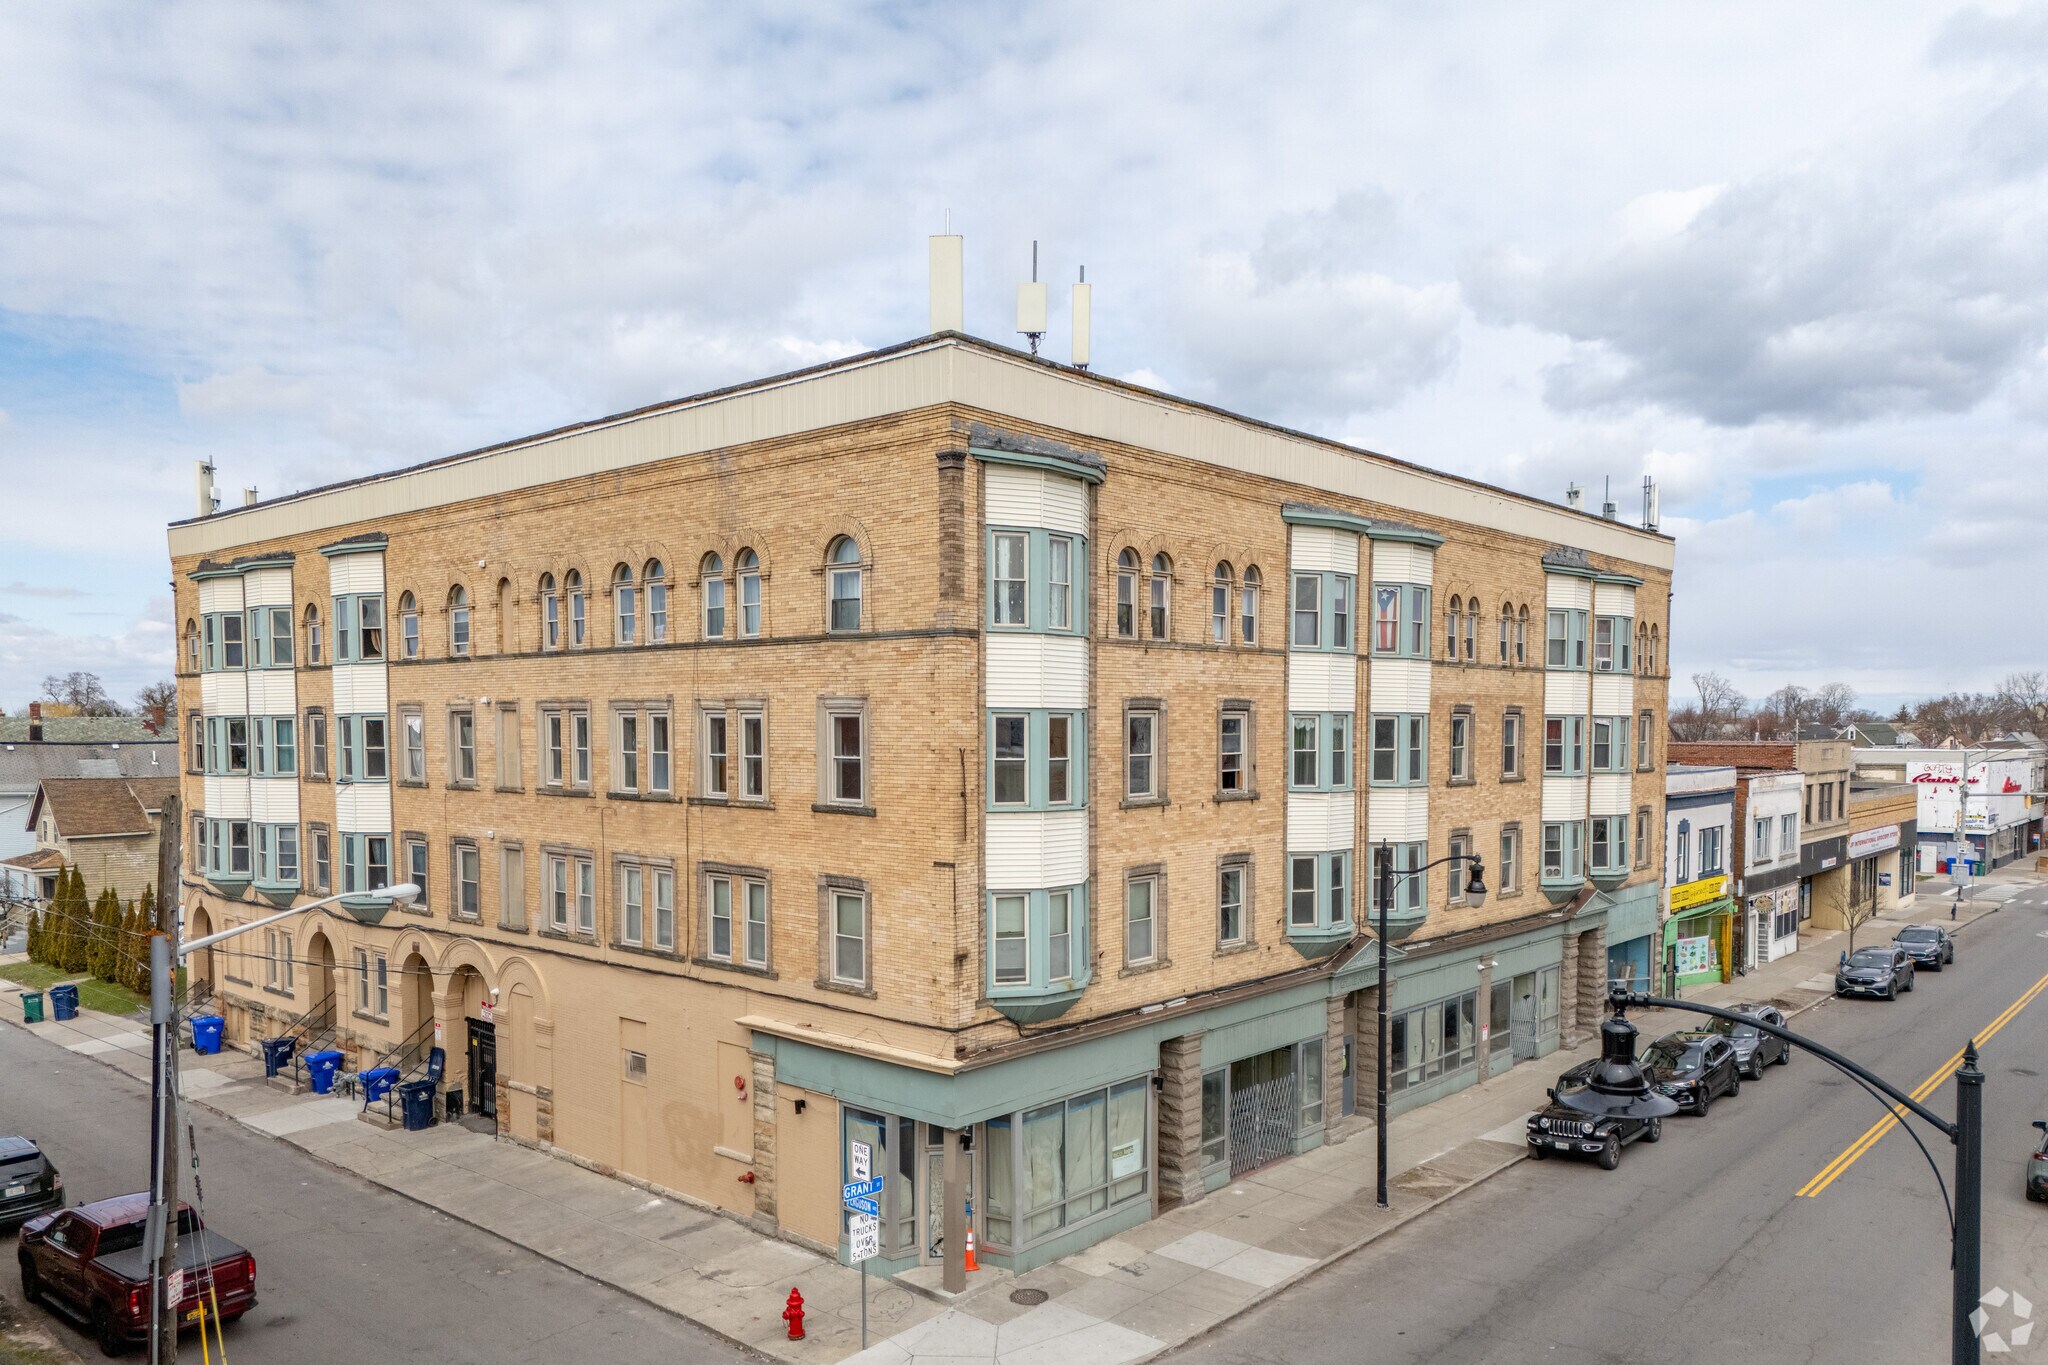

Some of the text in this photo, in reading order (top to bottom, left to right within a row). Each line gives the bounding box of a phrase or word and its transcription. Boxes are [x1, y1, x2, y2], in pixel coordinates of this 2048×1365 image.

[1912, 773, 1979, 783] Rainbw
[1855, 837, 1877, 847] INTERNATIONAL
[854, 1144, 868, 1157] ONE
[854, 1155, 868, 1166] WAY
[845, 1181, 873, 1198] GRANT
[860, 1214, 869, 1224] NO
[852, 1223, 877, 1236] TRUCKS
[856, 1235, 873, 1248] OVER
